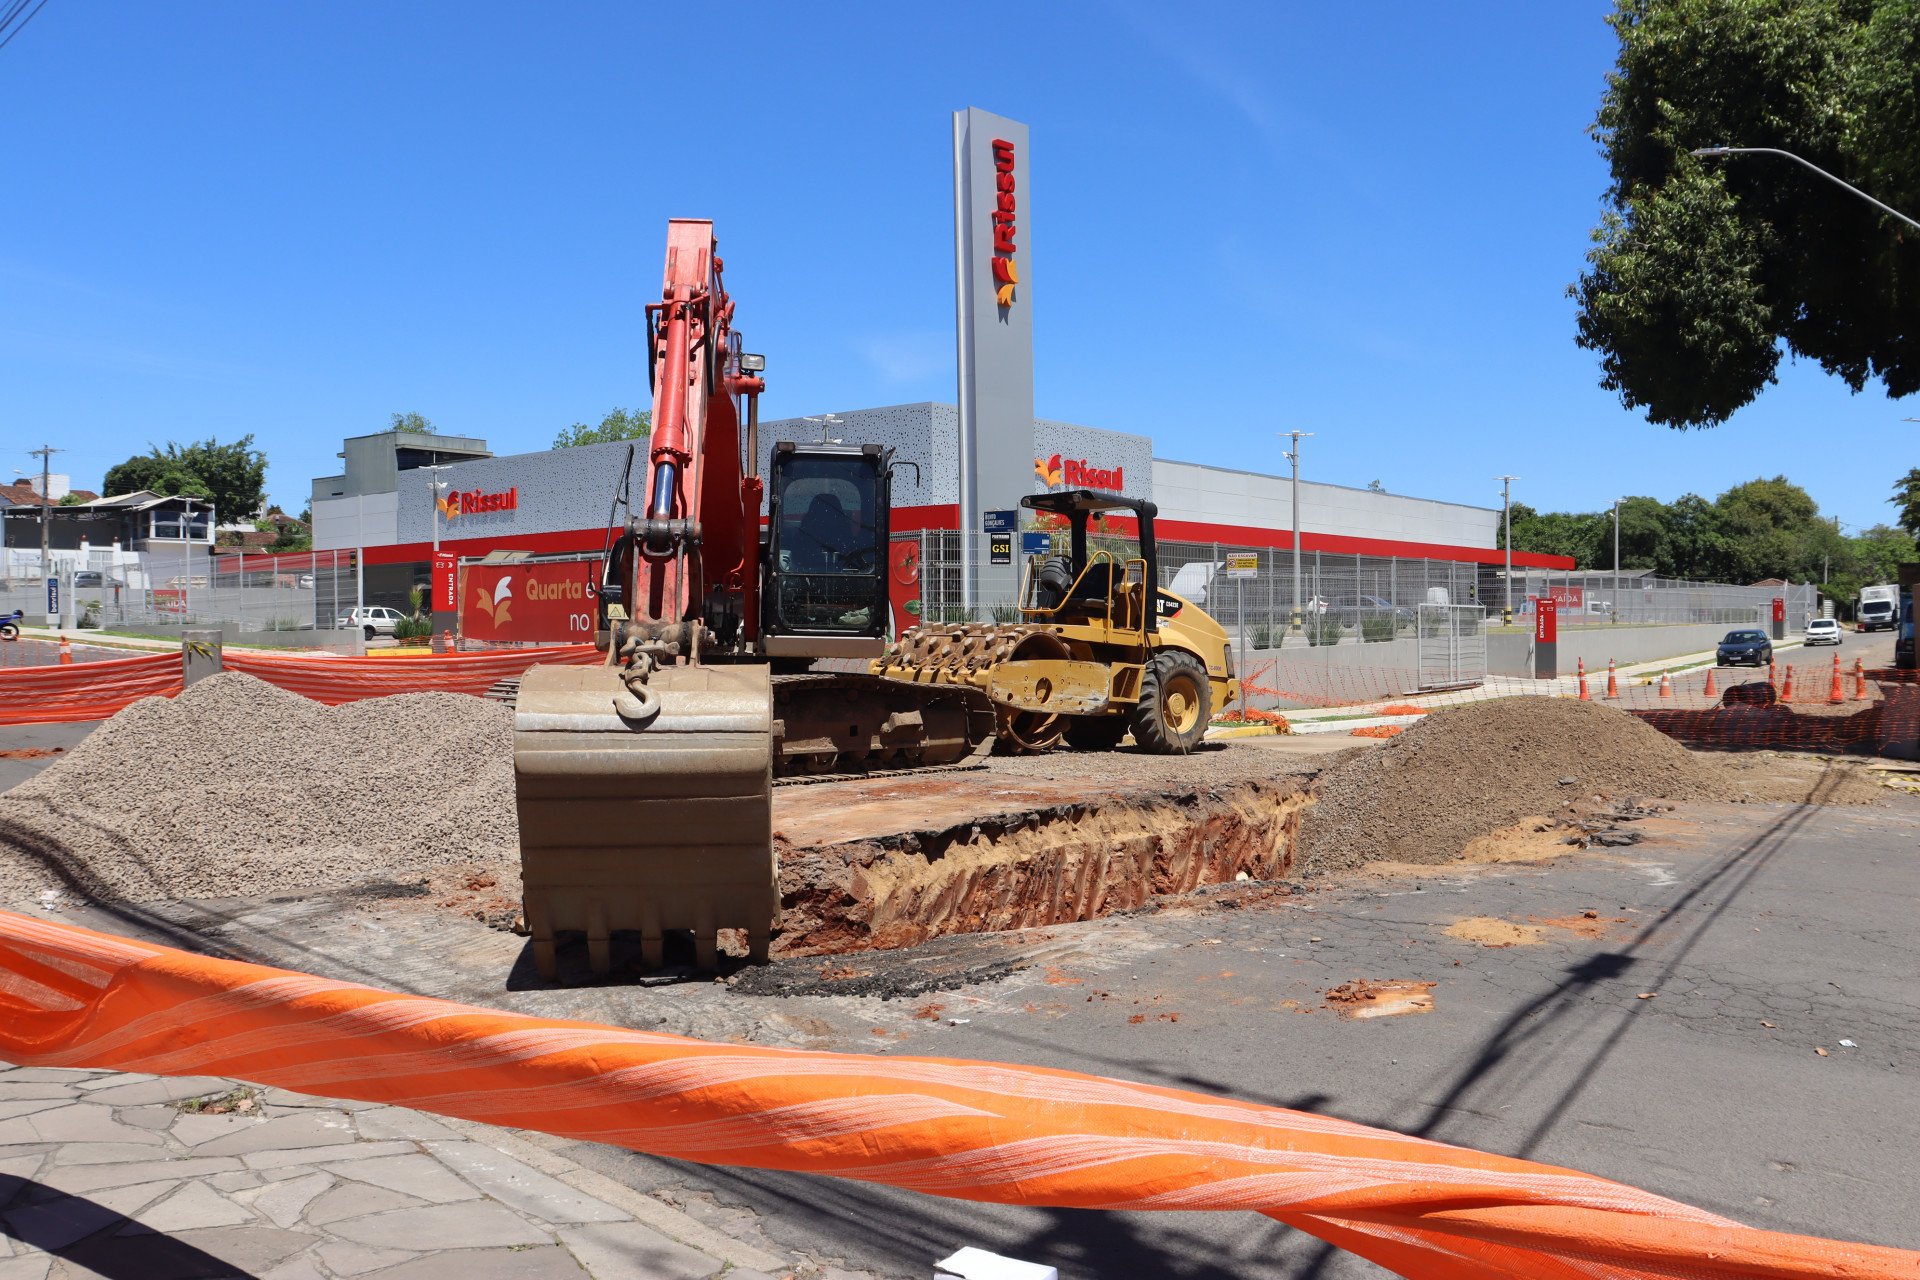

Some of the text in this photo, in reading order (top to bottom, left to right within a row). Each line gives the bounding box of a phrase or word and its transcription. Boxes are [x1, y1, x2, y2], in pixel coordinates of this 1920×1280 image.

[992, 139, 1016, 252] Rissul
[1064, 459, 1123, 491] Rissul
[461, 486, 517, 514] Rissul
[992, 544, 1009, 553] GSI
[526, 578, 582, 600] Quarta
[1156, 599, 1165, 613] AT
[570, 613, 590, 631] no
